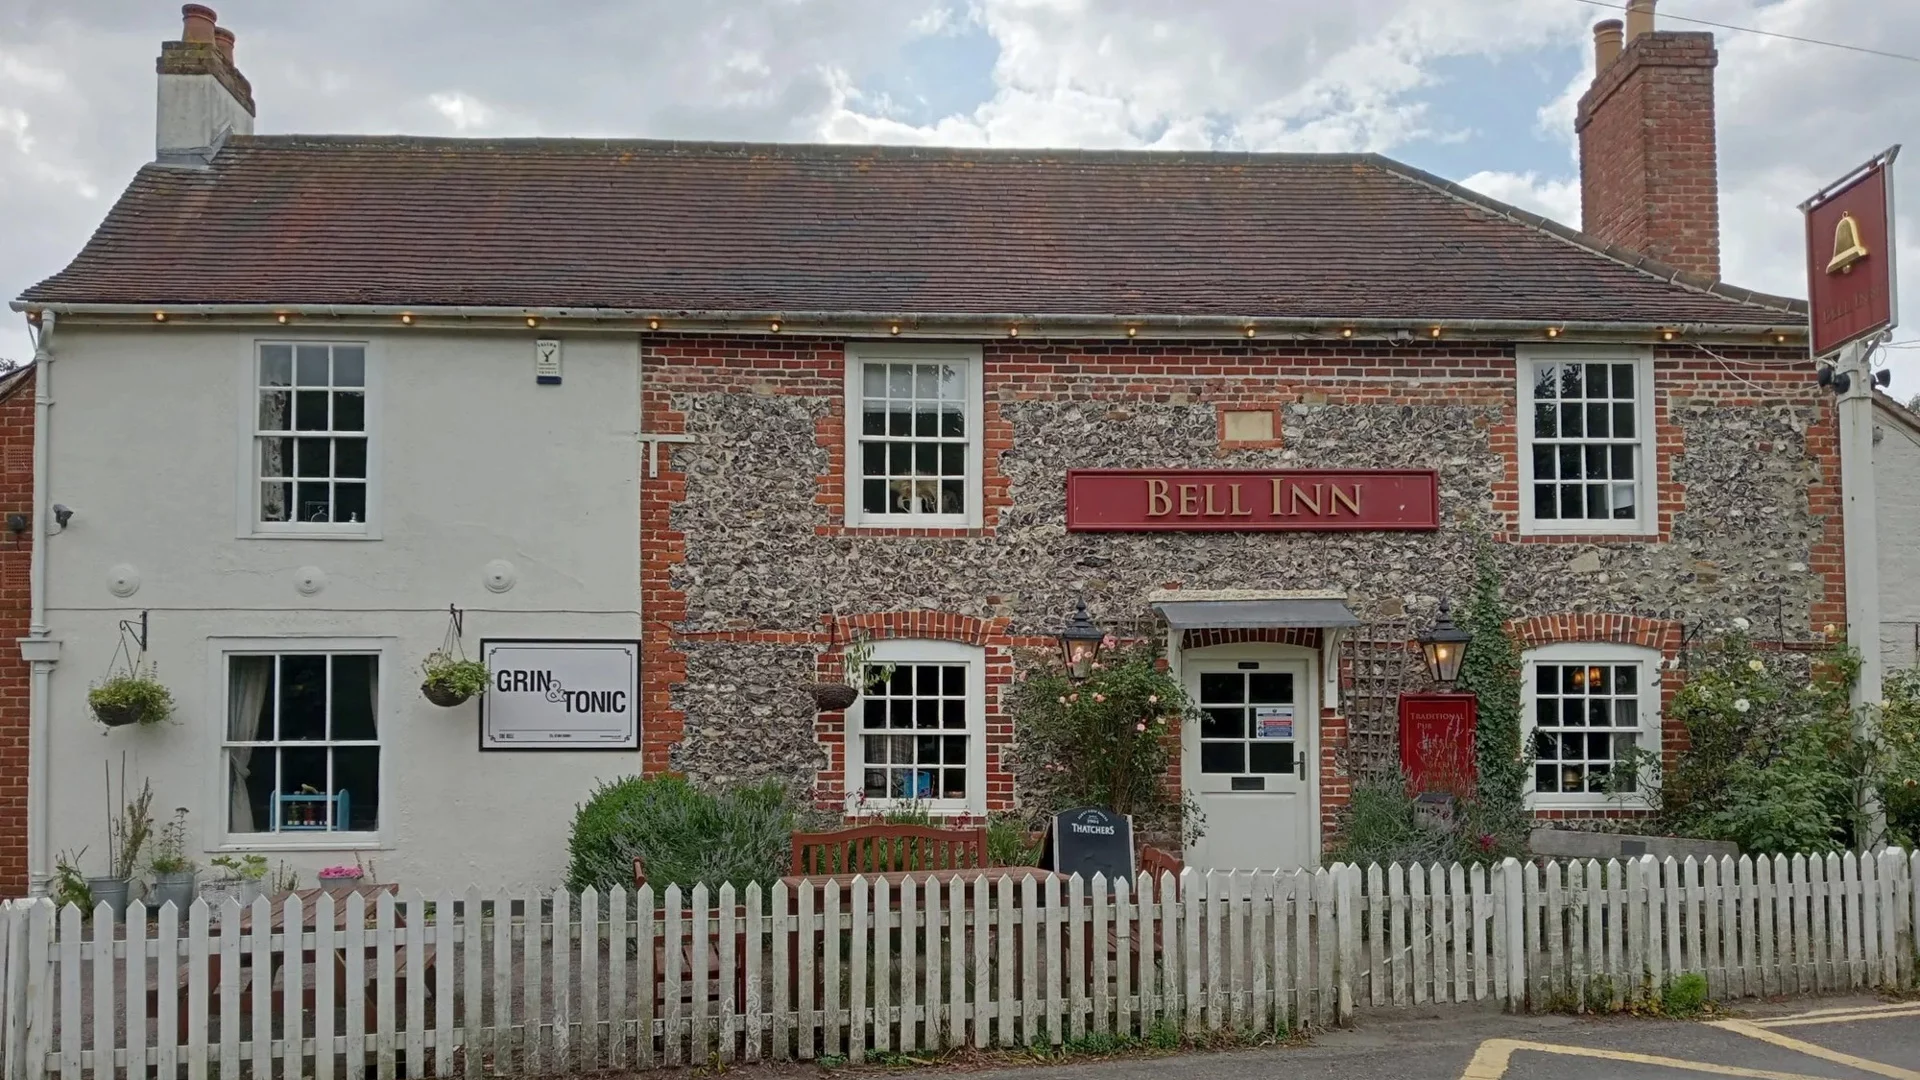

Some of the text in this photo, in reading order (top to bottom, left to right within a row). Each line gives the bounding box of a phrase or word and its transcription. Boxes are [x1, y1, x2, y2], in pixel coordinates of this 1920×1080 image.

[1145, 478, 1362, 516] BELL INN
[497, 669, 626, 713] GRIN & TONIC
[1071, 822, 1116, 836] THATCHERS
